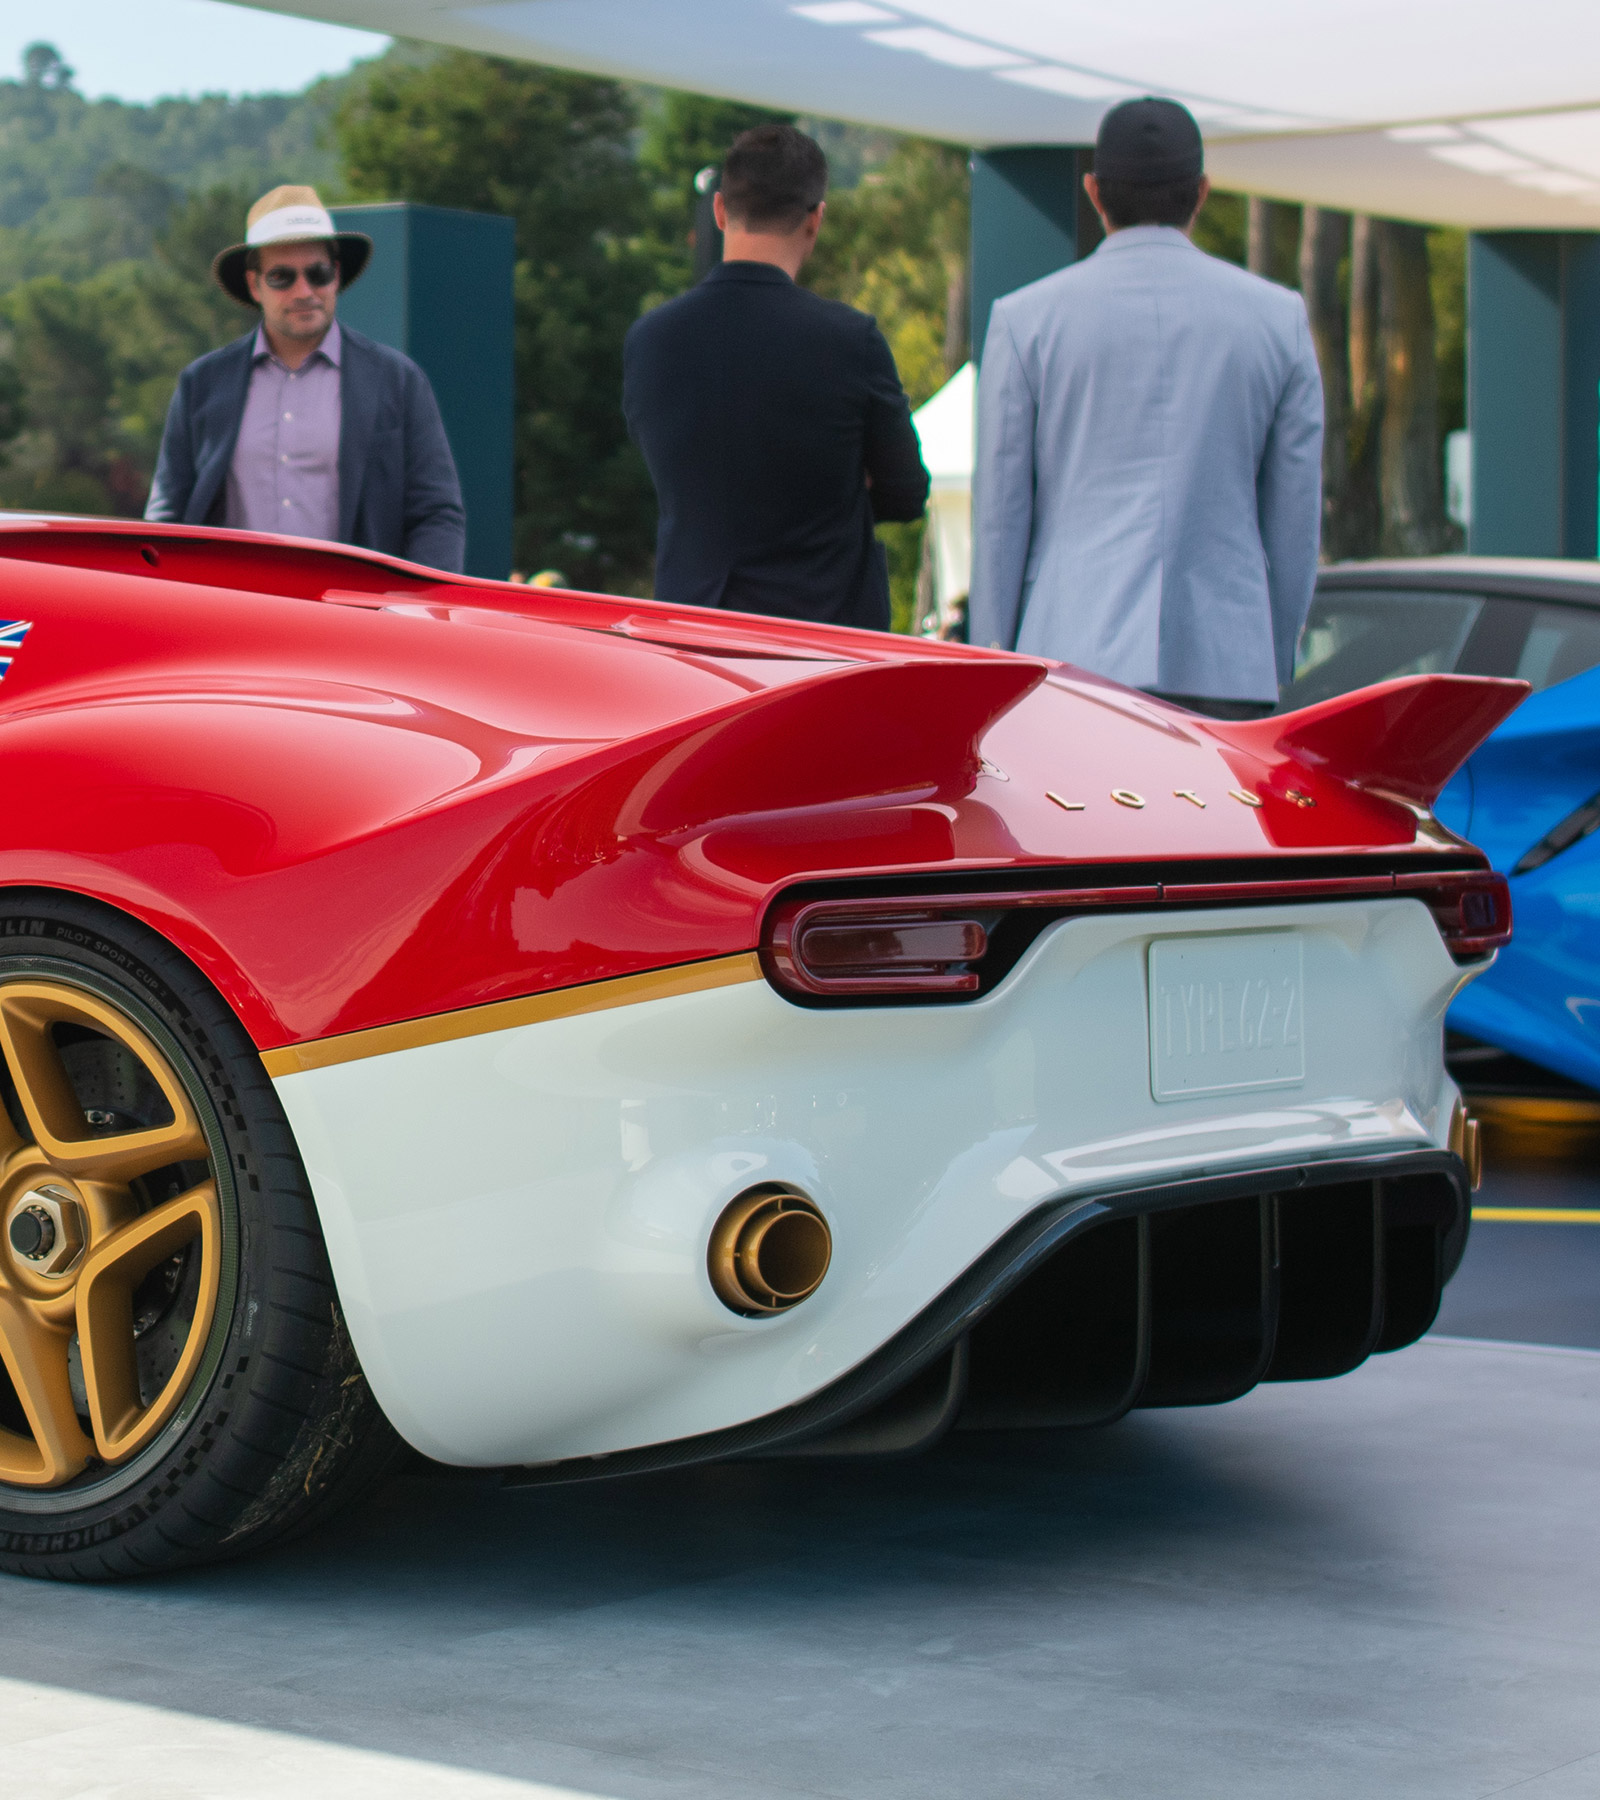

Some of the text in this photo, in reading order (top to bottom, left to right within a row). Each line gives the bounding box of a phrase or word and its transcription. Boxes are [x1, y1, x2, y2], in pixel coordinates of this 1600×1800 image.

[56, 927, 91, 945] PILOT
[95, 941, 134, 968] SPORT
[135, 968, 158, 988] CUP
